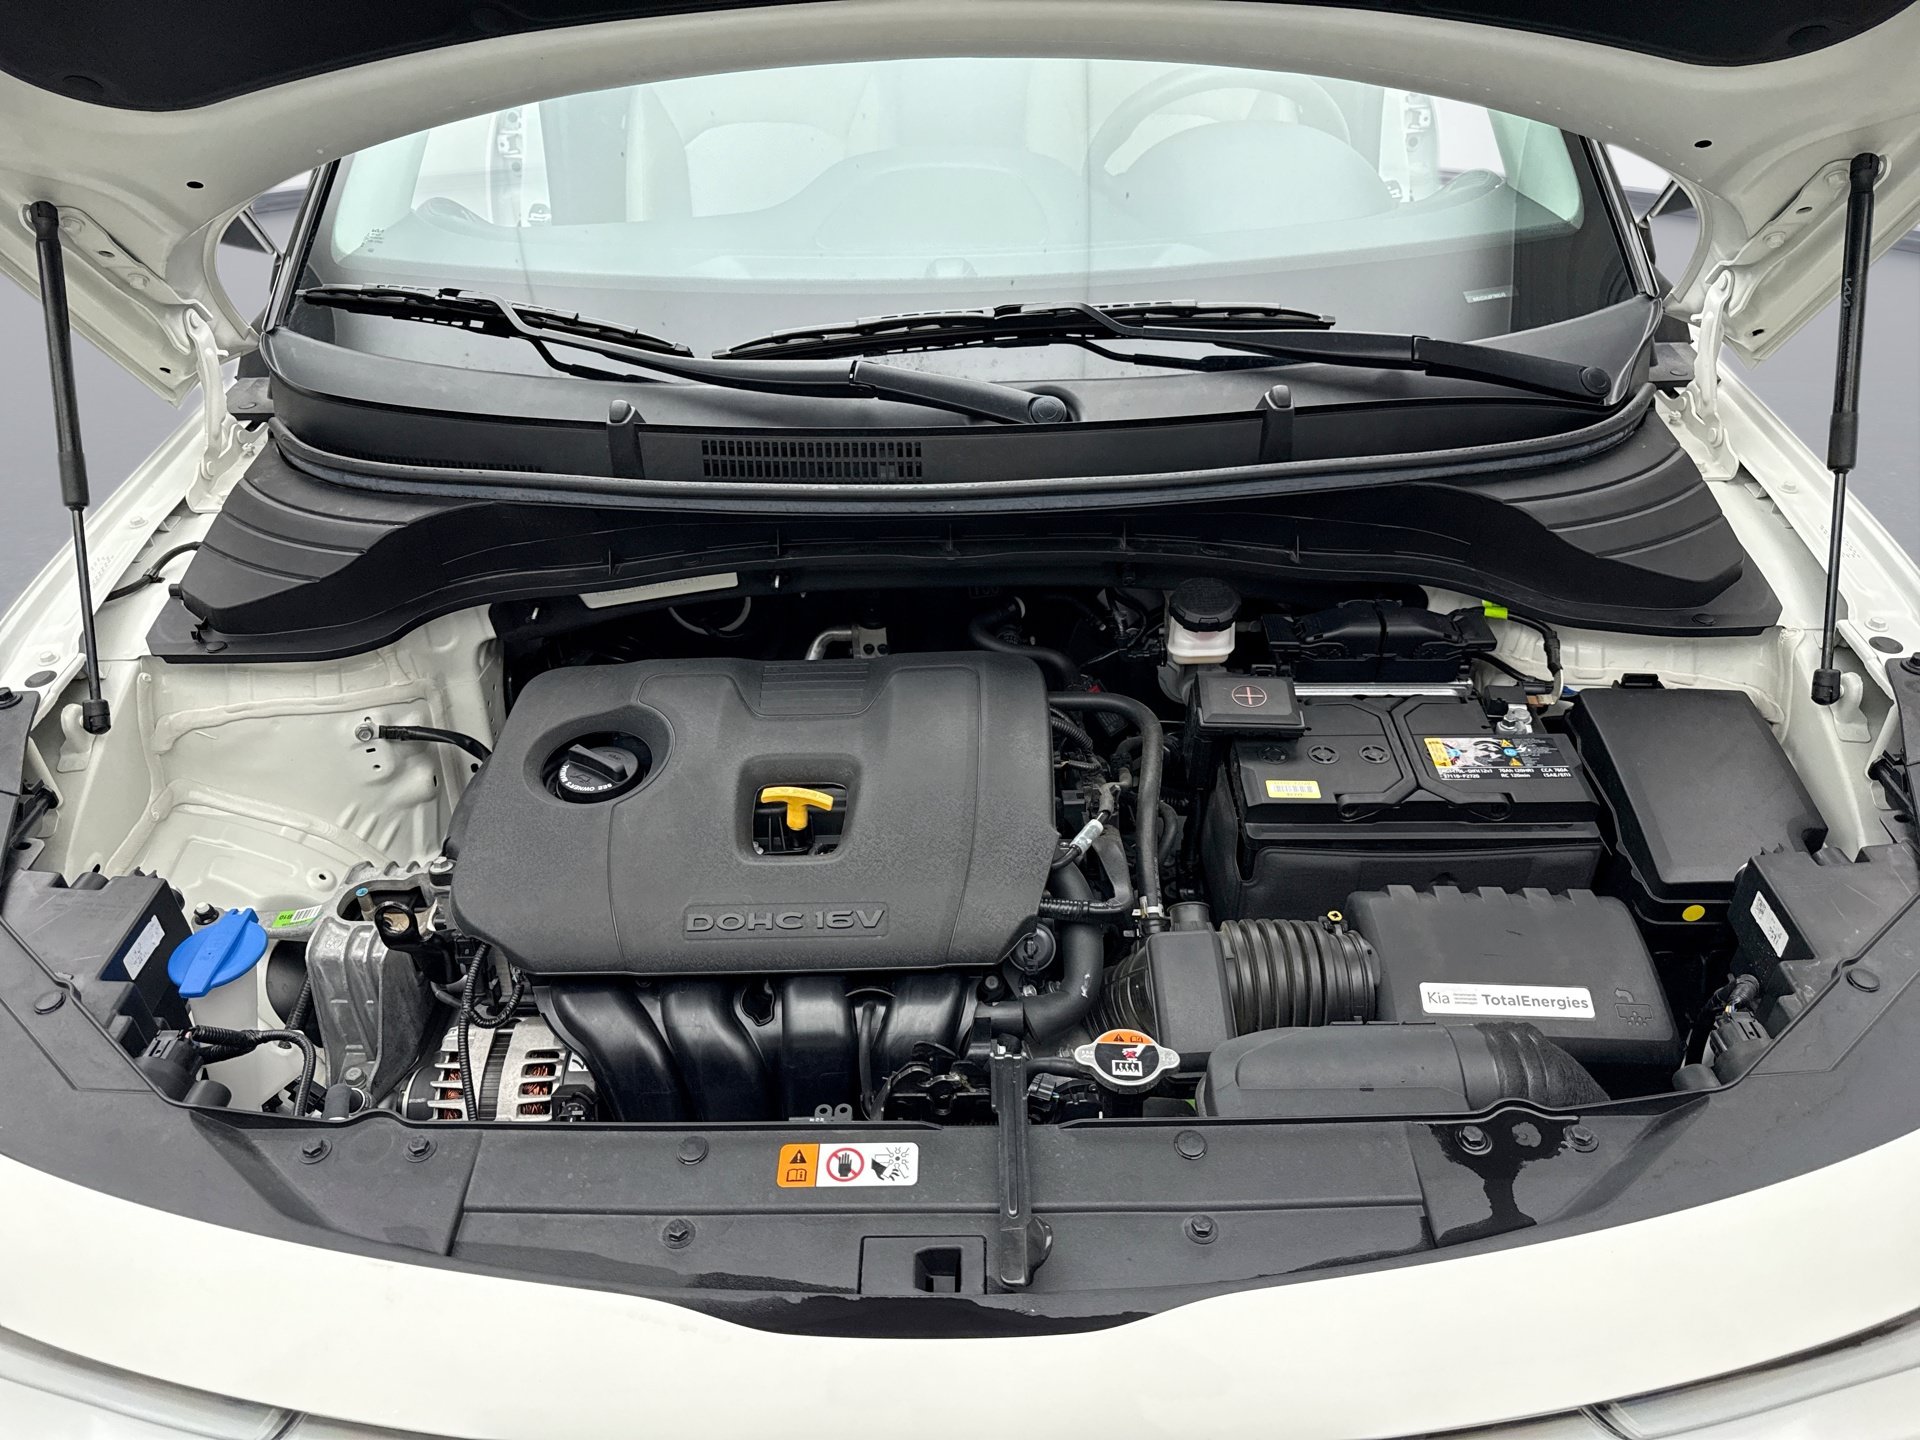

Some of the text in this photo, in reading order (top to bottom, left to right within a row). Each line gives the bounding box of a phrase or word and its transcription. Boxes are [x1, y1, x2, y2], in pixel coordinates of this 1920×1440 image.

[686, 909, 885, 932] DOHC 16V
[1427, 991, 1450, 1005] Kia
[1481, 993, 1589, 1011] TotalEnergies
